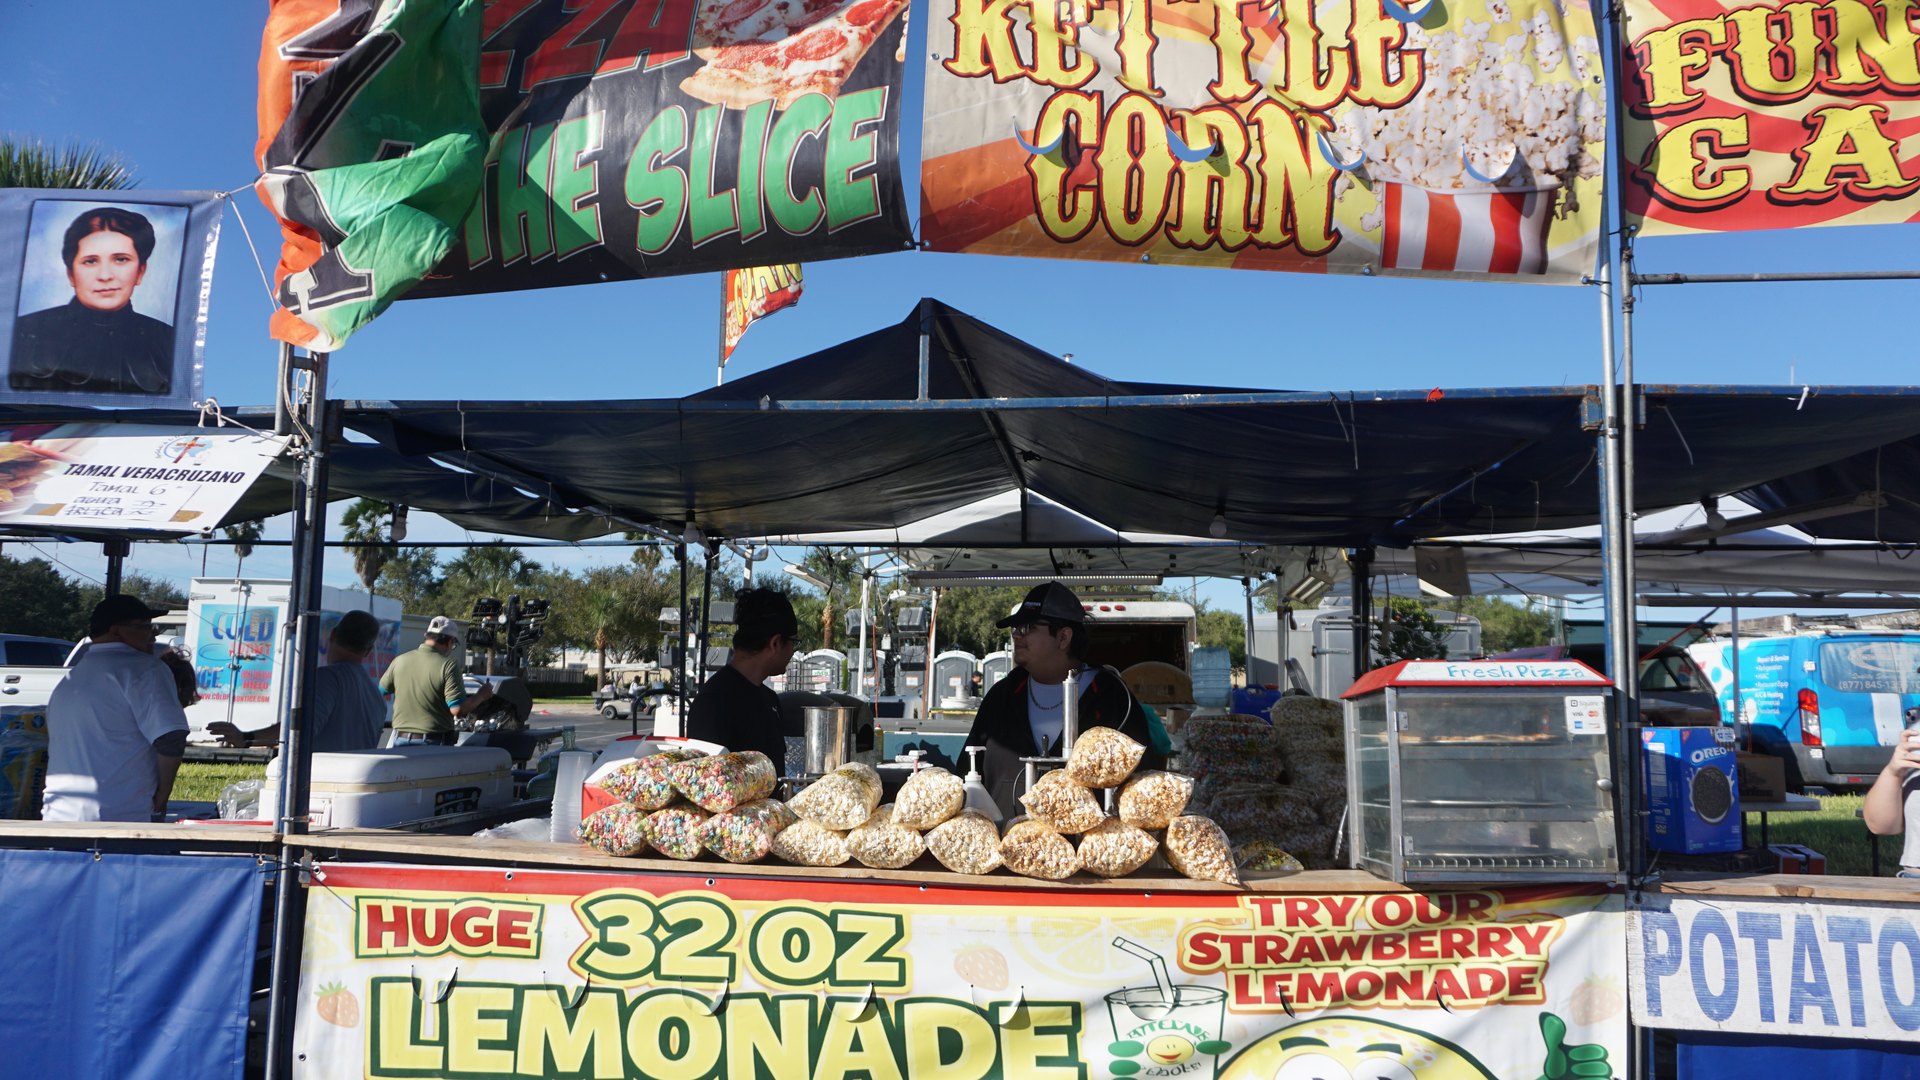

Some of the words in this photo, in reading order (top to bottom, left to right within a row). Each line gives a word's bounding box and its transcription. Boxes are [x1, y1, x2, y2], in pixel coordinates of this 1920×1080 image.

[623, 85, 890, 256] SLICE
[1026, 90, 1342, 256] CORN
[63, 463, 121, 478] TAMAL
[121, 466, 246, 484] VERACRUZANO
[212, 608, 275, 641] COLD
[1446, 665, 1511, 678] Fresh
[1516, 664, 1585, 679] Pizza
[1839, 680, 1864, 690] (877)
[1691, 746, 1727, 764] OREO
[1249, 896, 1363, 928] TRY
[1371, 893, 1493, 926] OUR
[366, 903, 534, 949] HUGE
[580, 896, 734, 980] 32
[753, 904, 902, 985] OZ
[1188, 924, 1556, 966] STRAWBERRY
[1233, 966, 1538, 1005] LEMONADE
[1641, 907, 1920, 1031] POTATO
[374, 978, 1081, 1080] LEMONADE
